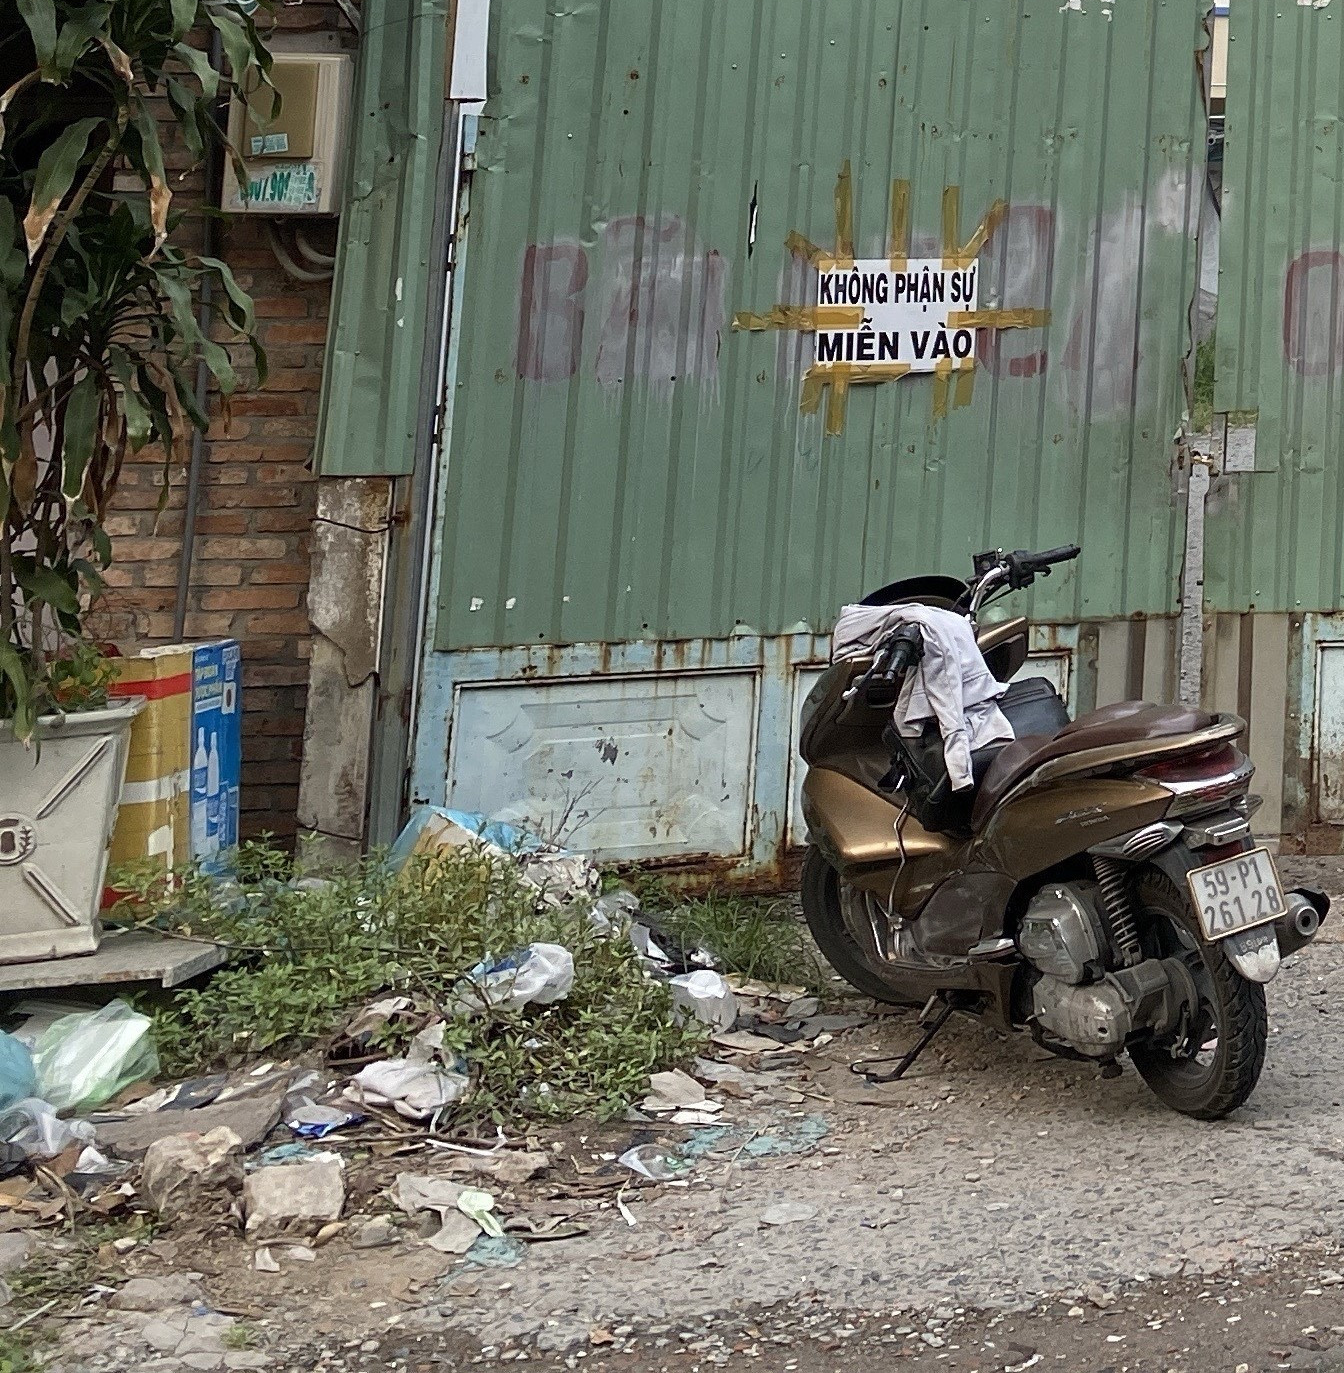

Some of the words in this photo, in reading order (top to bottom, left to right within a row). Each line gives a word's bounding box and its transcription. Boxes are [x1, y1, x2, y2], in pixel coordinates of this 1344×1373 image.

[820, 267, 888, 305] KHÔNG
[894, 266, 945, 313] PHẬN
[951, 265, 977, 312] SỰ
[818, 317, 899, 362] MIỄN
[911, 322, 972, 360] VÀO
[1201, 857, 1263, 899] 59-P1
[1204, 885, 1281, 935] 261.28
